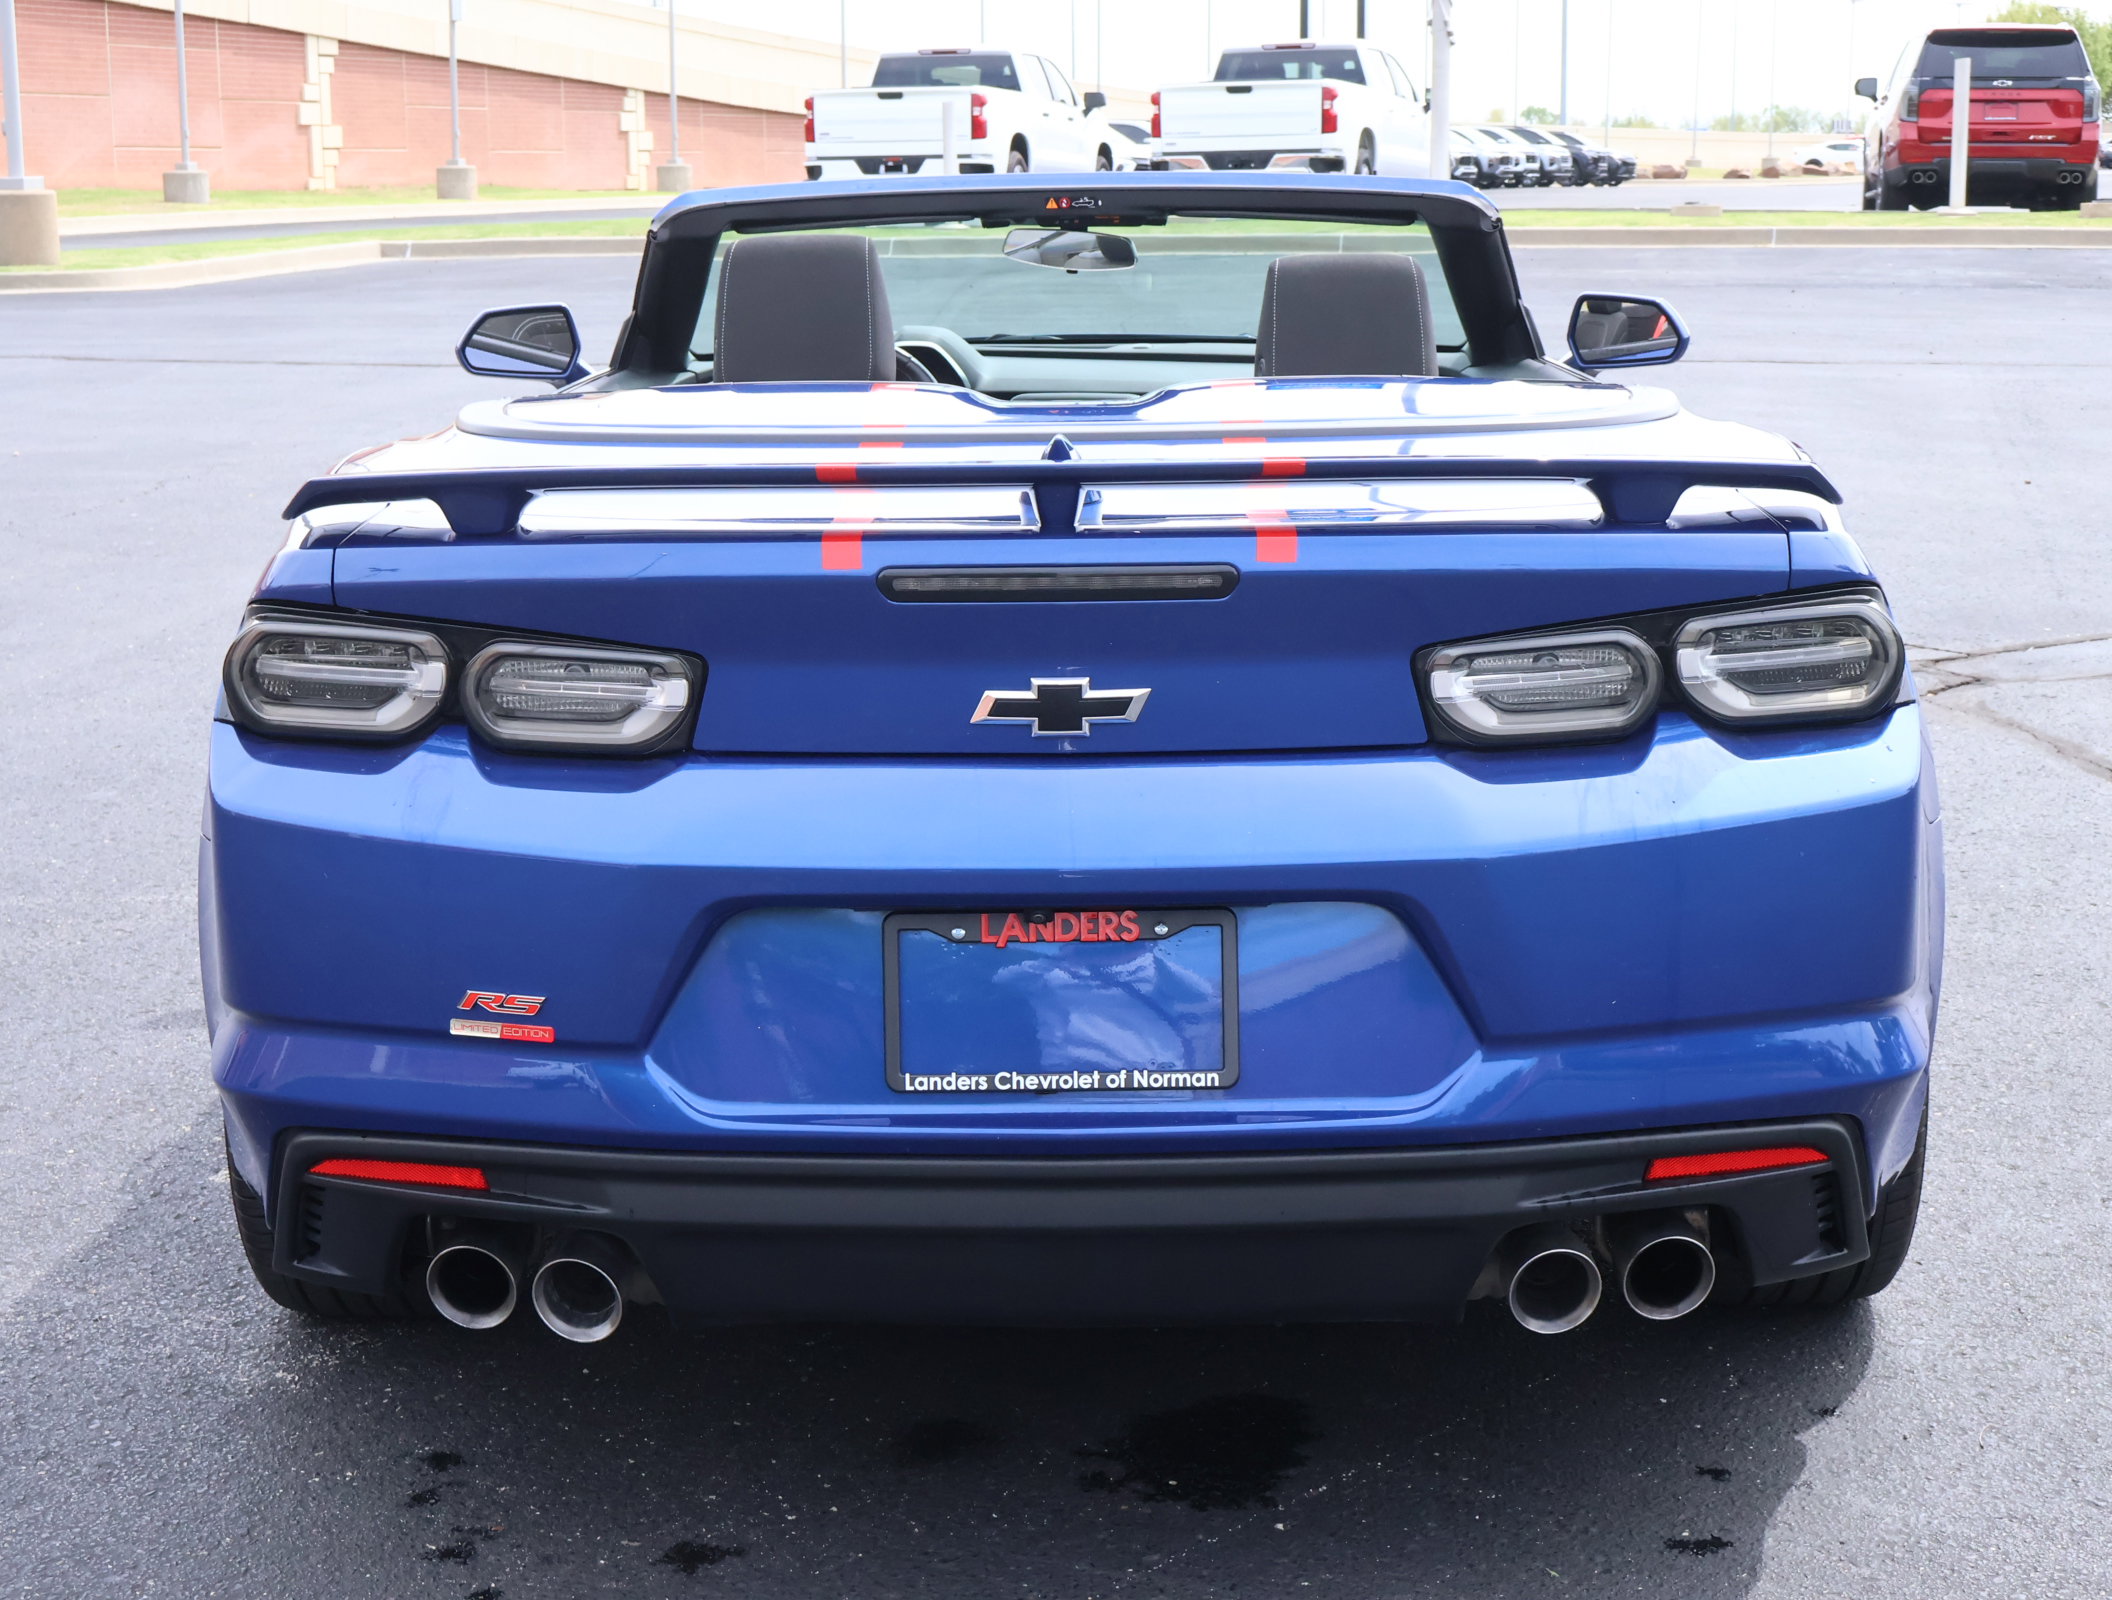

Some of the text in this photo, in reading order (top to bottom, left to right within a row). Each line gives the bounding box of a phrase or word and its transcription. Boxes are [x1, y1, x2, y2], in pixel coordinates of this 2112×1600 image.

[980, 910, 1141, 948] LANDERS
[457, 989, 547, 1016] RS
[453, 1021, 550, 1039] LIMITED EDITION
[904, 1069, 1220, 1091] Landers Chevrolet of Norman
